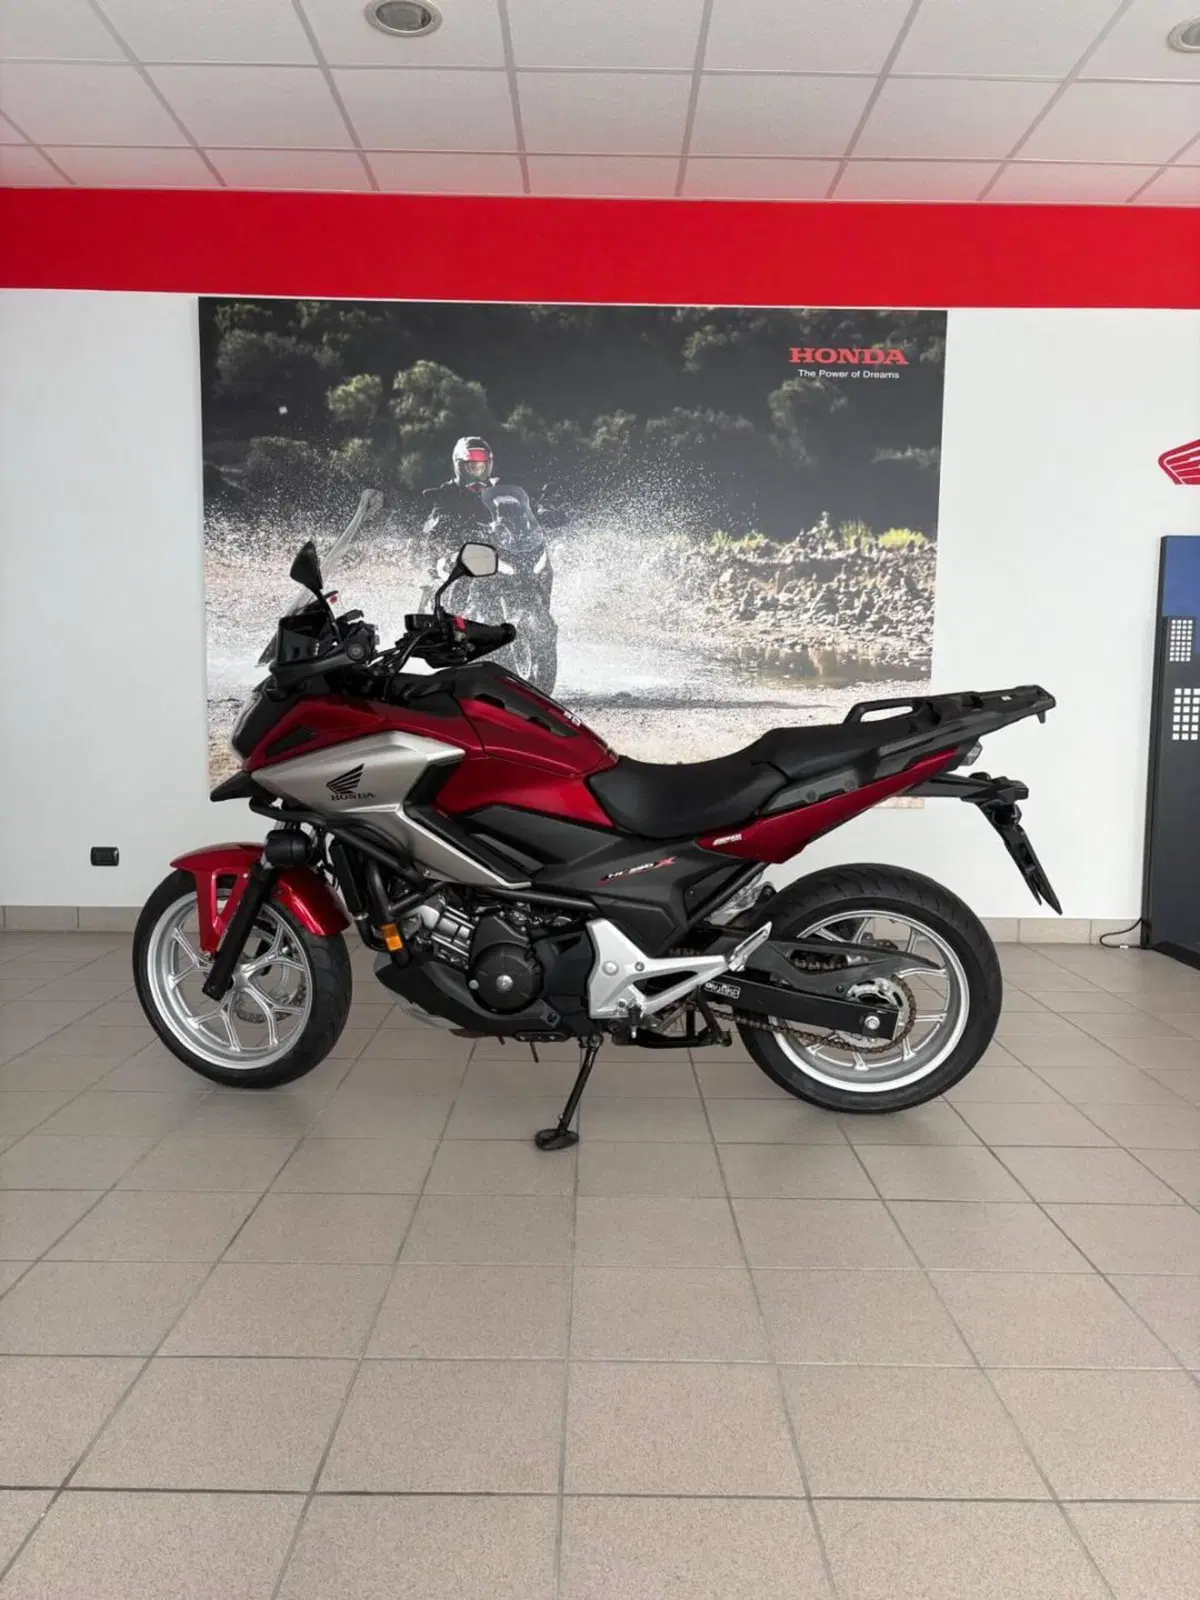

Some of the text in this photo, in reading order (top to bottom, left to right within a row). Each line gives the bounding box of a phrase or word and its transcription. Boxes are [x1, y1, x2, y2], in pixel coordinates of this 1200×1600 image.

[789, 347, 909, 365] HONDA
[798, 369, 900, 380] The Power of Dreams
[330, 792, 376, 801] HONDA
